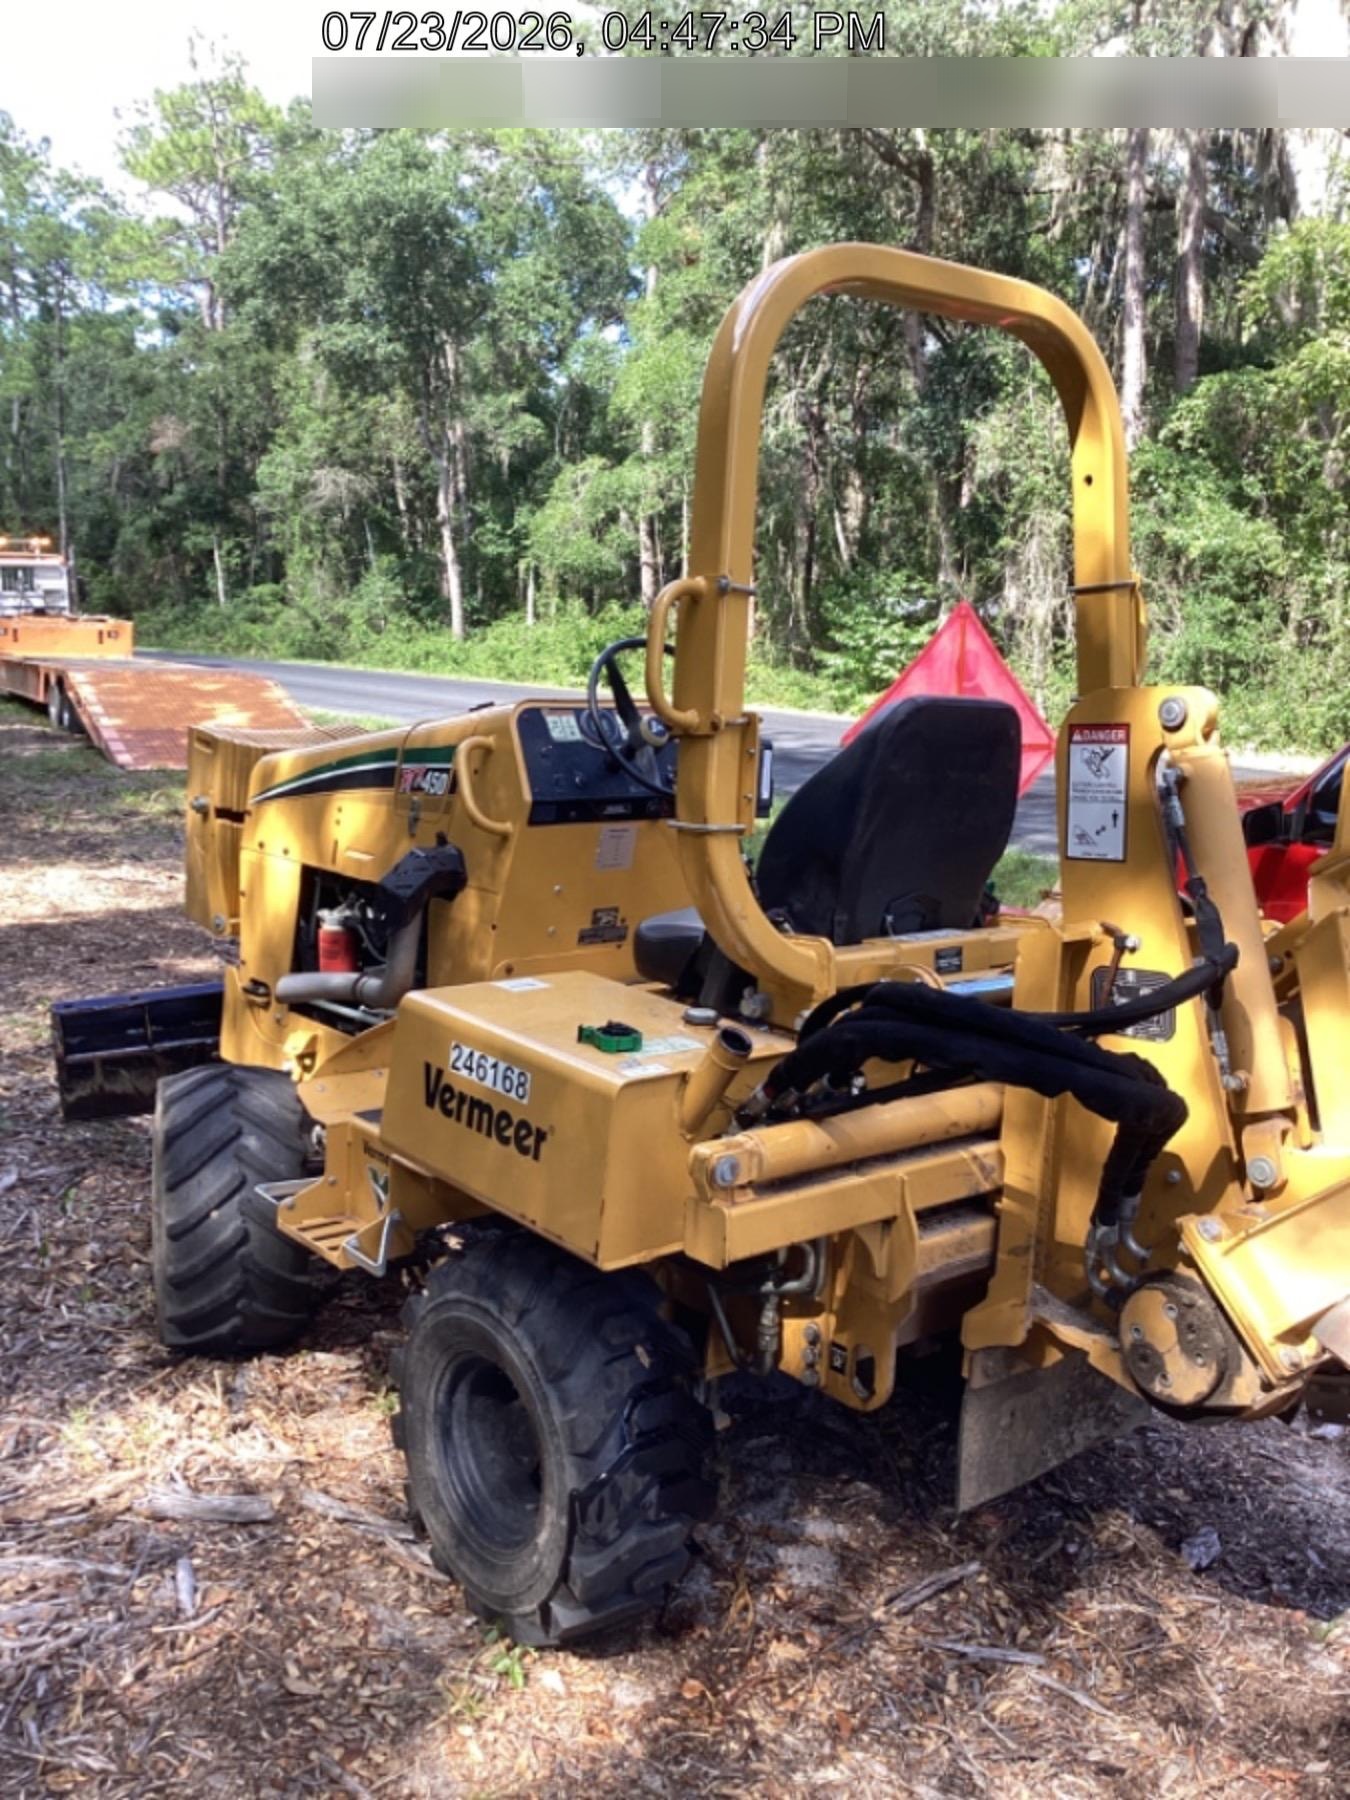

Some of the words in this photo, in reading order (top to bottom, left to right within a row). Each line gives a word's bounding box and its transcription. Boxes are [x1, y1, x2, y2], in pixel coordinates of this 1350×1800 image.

[1081, 729, 1127, 742] DANGER
[451, 1044, 529, 1101] 246168
[424, 1061, 548, 1162] Vermeer
